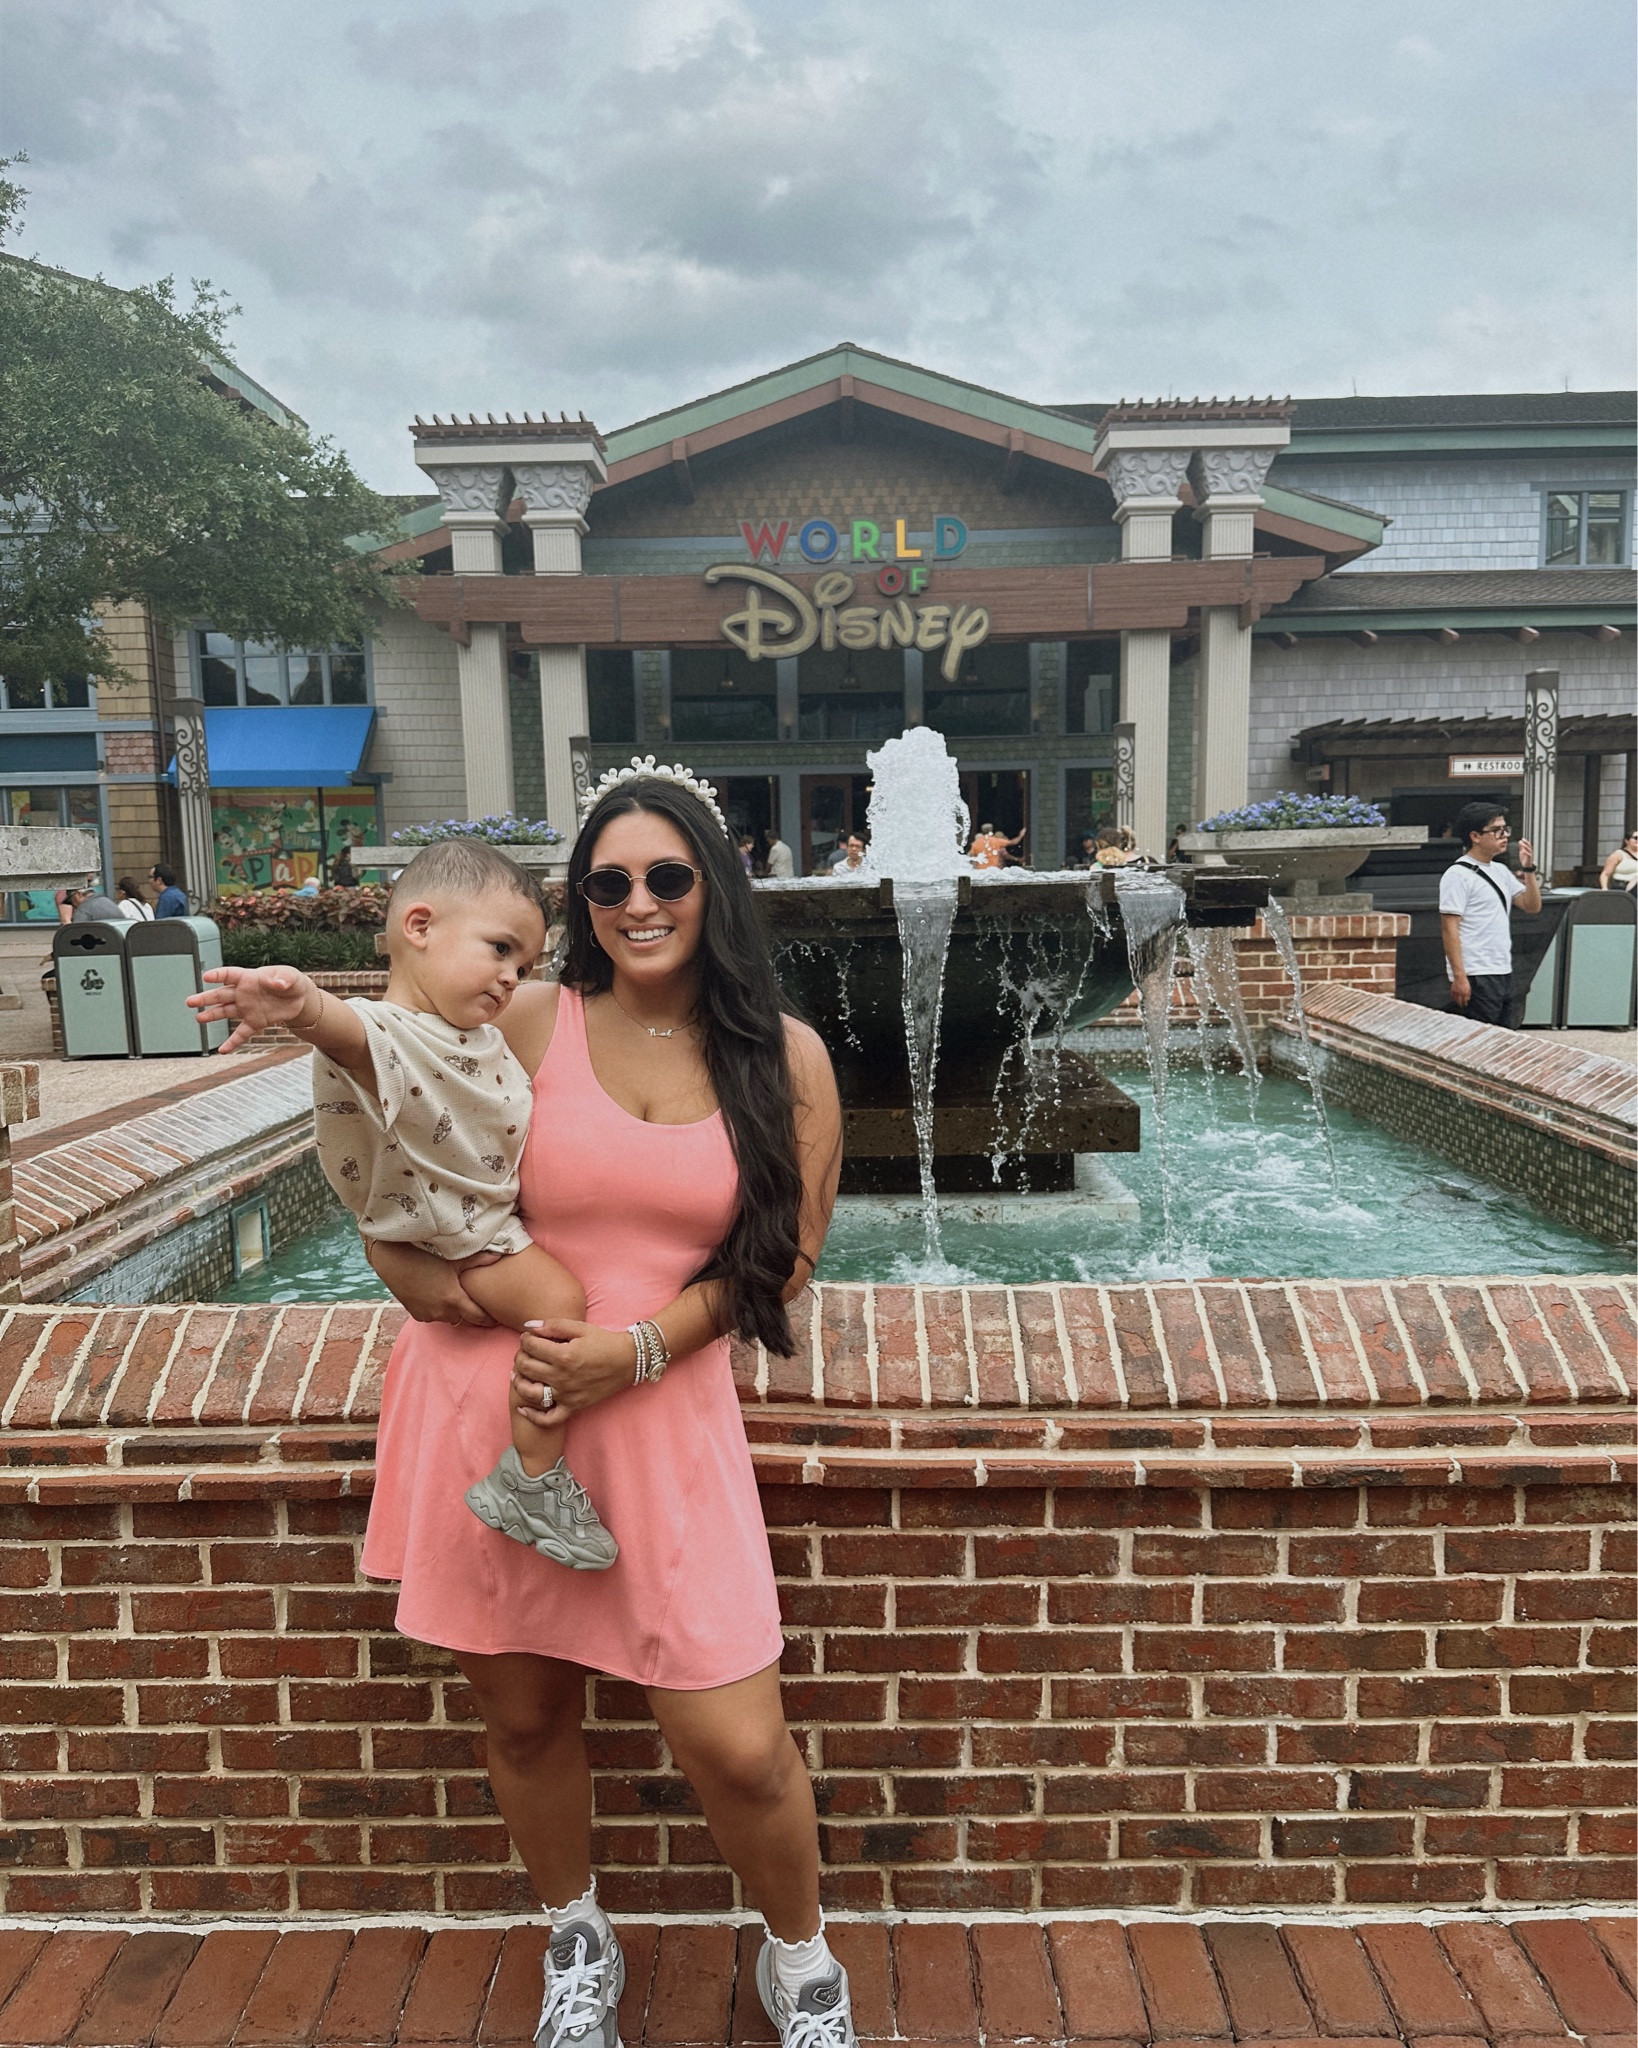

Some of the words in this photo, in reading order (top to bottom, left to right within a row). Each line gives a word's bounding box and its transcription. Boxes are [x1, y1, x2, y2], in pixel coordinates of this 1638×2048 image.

[739, 516, 968, 563] WORLD
[878, 566, 929, 595] OF
[1477, 761, 1526, 771] RESTROO
